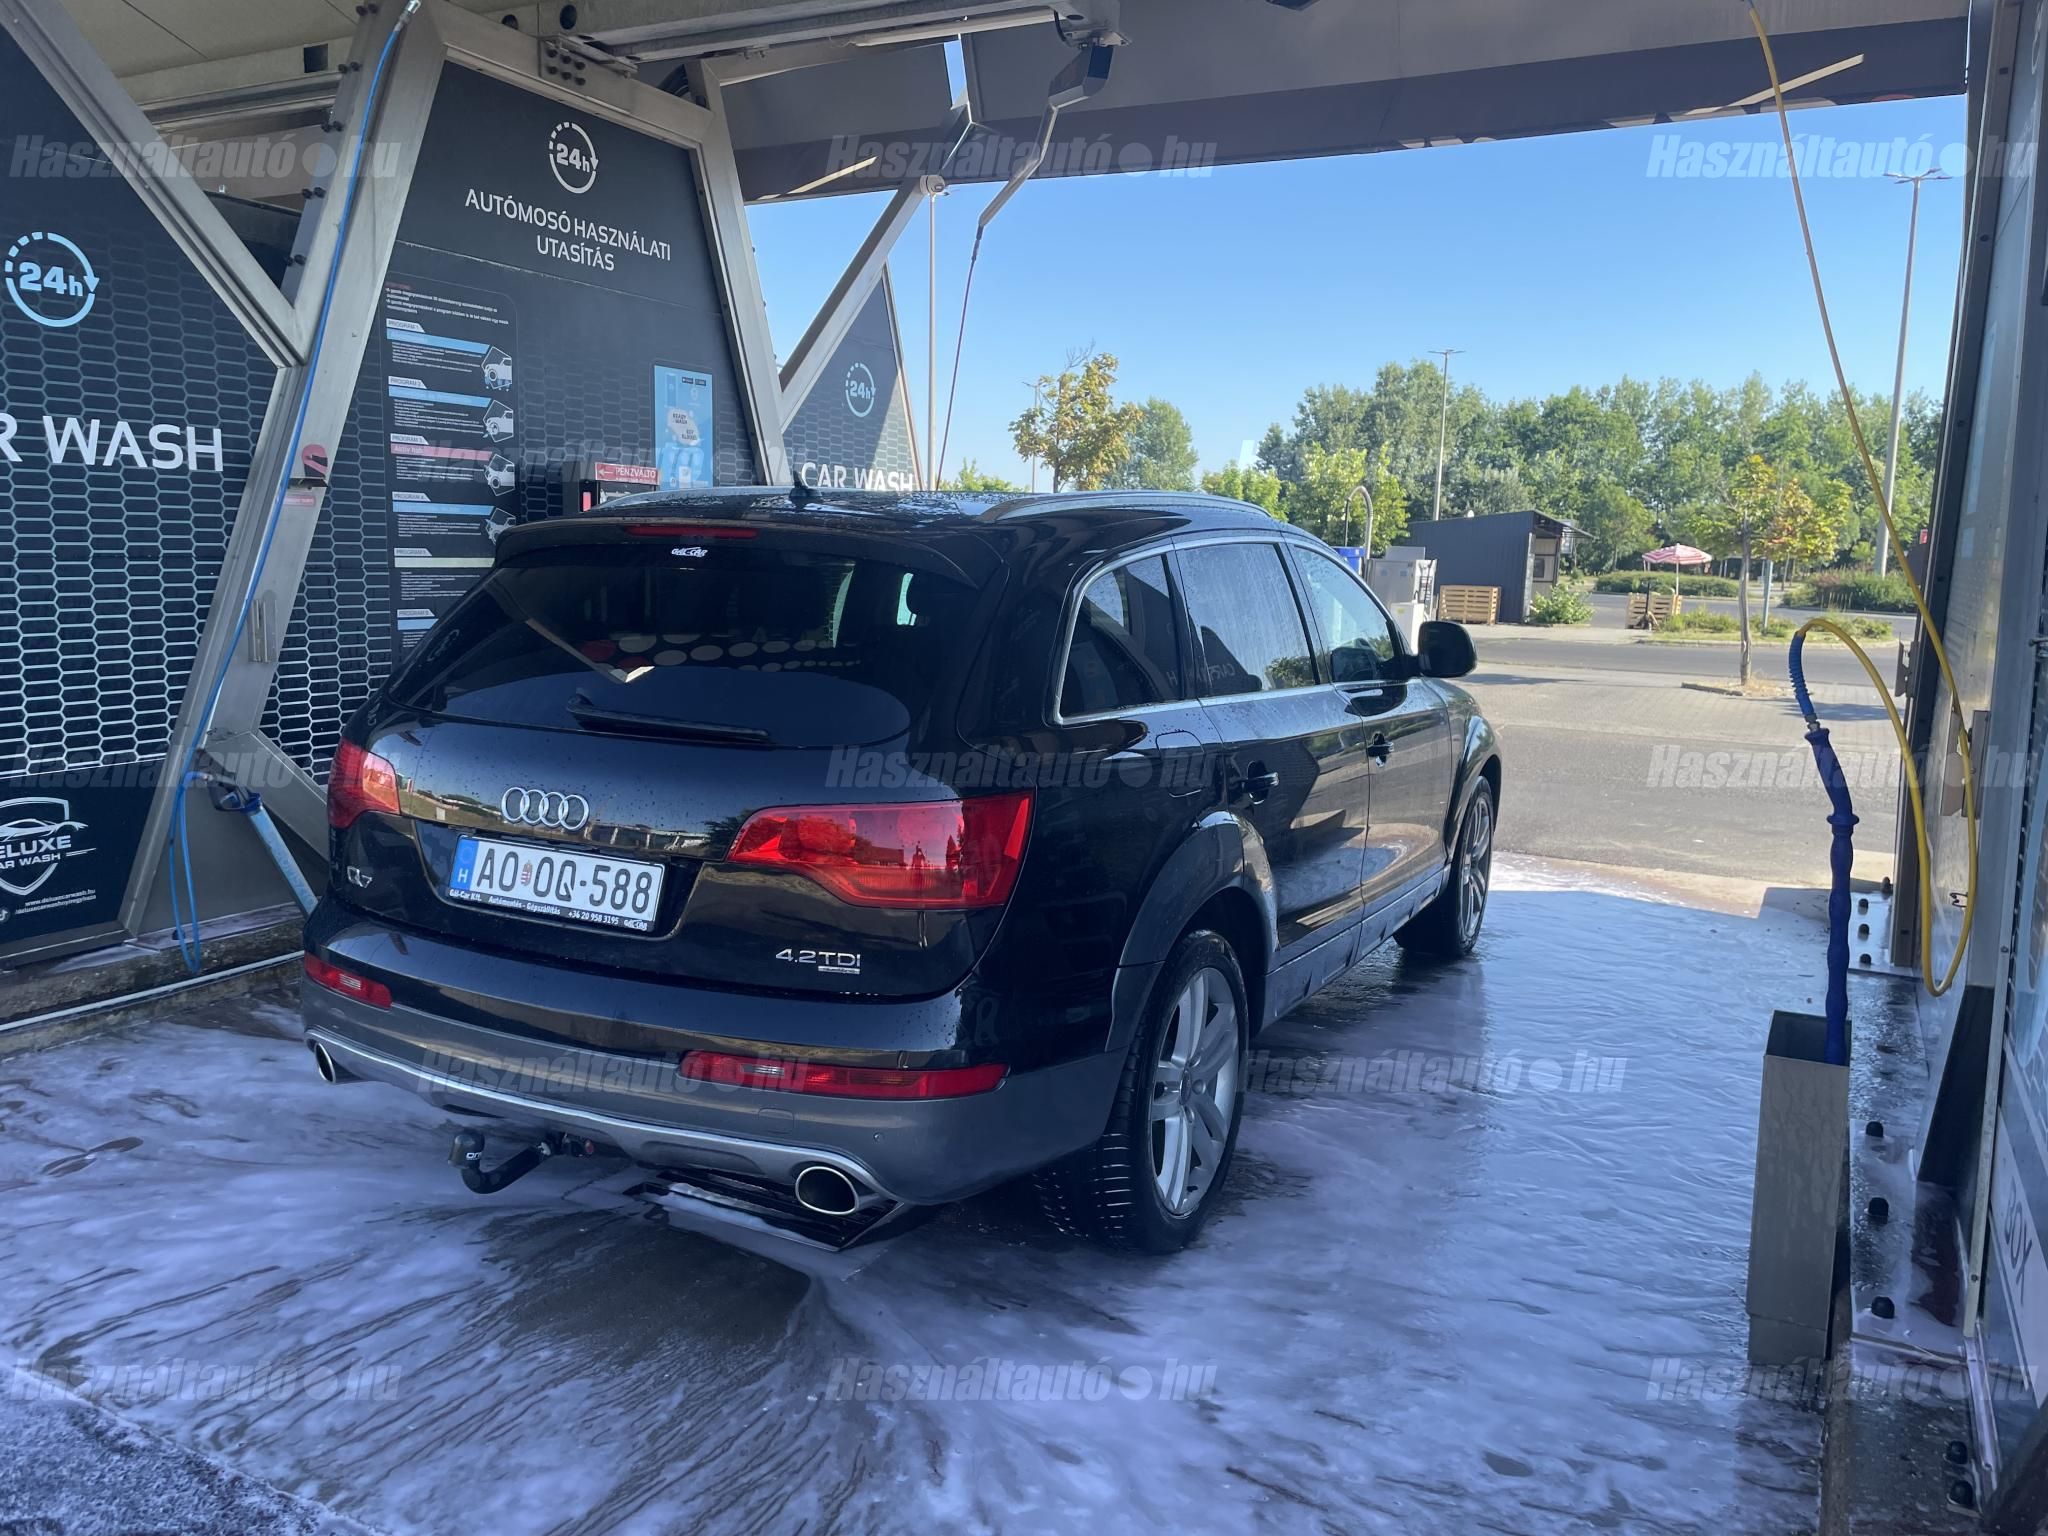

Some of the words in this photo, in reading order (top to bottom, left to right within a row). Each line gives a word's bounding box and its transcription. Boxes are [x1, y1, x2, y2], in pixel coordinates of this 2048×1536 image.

[556, 143, 590, 172] 24h
[464, 188, 571, 234] AUTÓMOSÓ
[574, 217, 671, 261] HASZNÁLATI
[537, 235, 615, 271] UTASÍTÁS
[19, 262, 83, 296] 24h
[850, 380, 871, 399] 24h
[43, 415, 223, 472] WASH
[801, 462, 847, 489] CAR
[854, 467, 913, 493] WASH
[19, 852, 61, 867] WASH
